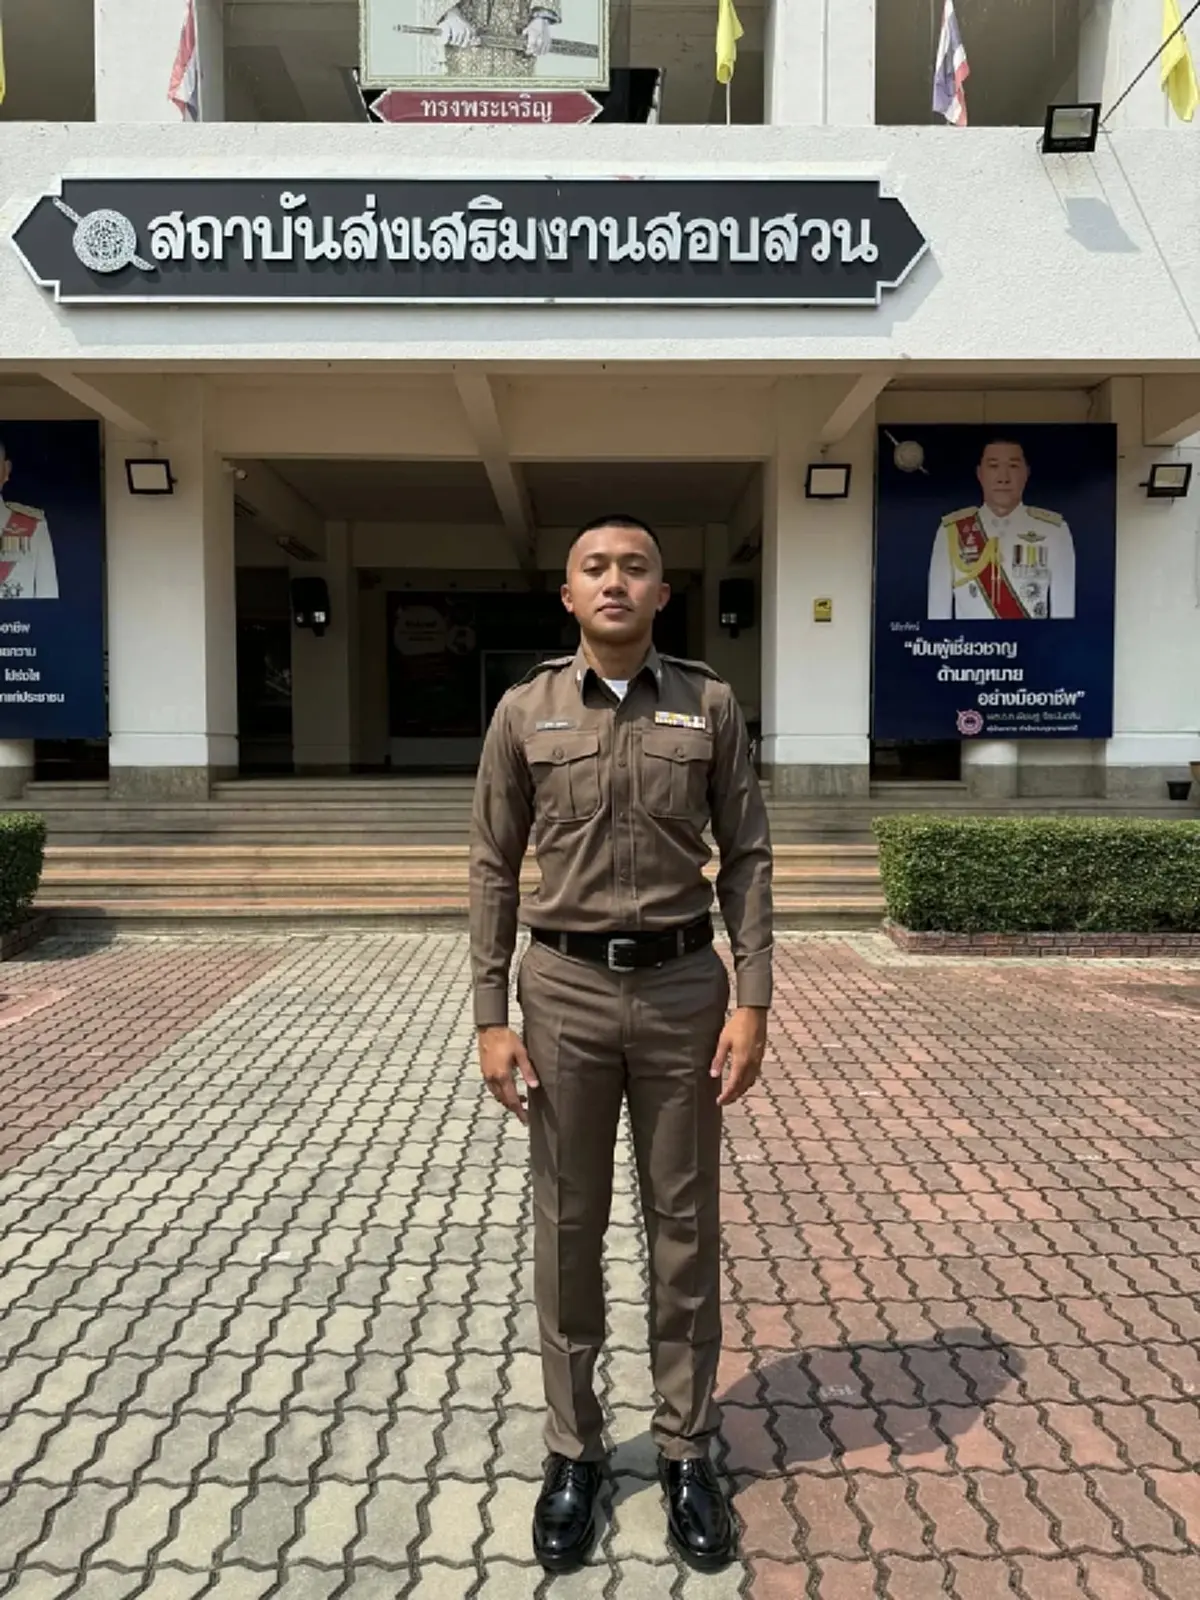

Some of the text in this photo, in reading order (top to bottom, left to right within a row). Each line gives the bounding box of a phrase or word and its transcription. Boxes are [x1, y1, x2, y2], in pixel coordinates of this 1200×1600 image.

[421, 93, 553, 123] ทรงพระเจริญ
[147, 191, 879, 263] สถาบันส่งเสริมงานสอบสวน
[936, 664, 1024, 686] ด้านกฎหมาย
